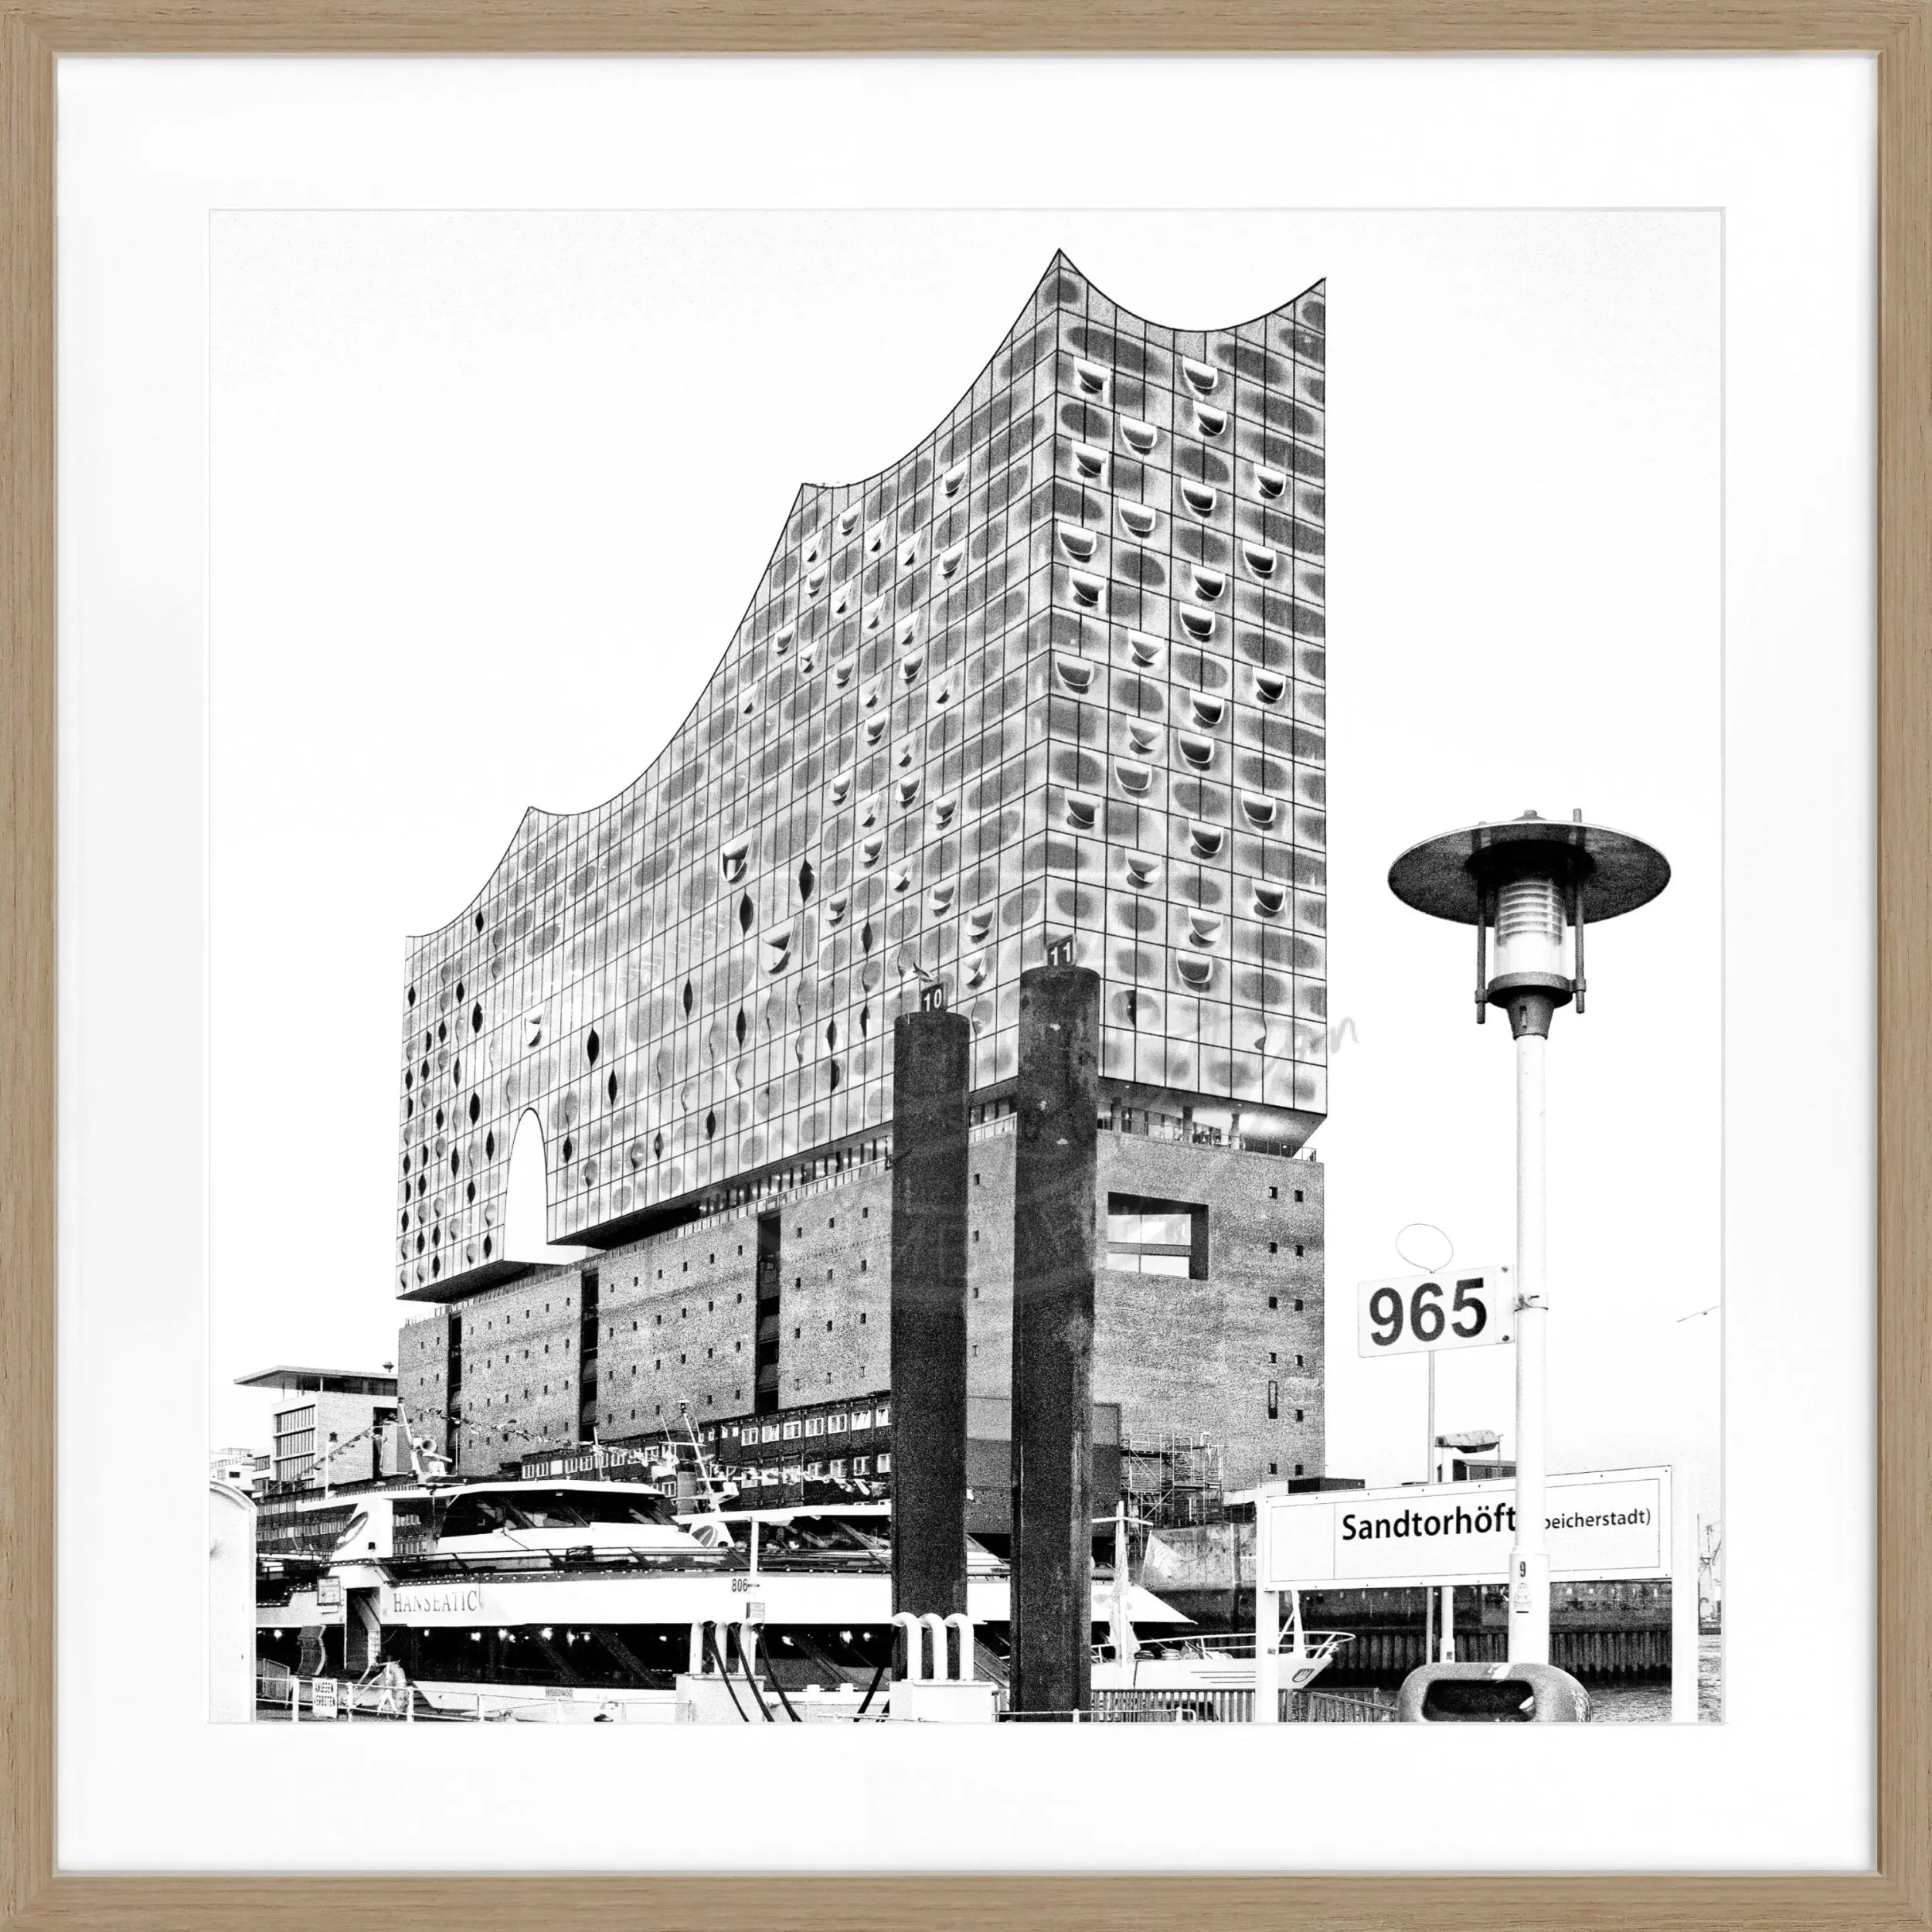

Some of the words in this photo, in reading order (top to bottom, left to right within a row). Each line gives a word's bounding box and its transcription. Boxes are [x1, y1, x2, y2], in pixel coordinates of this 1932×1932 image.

[1049, 941, 1072, 966] 11
[923, 988, 943, 1012] 10
[1369, 1277, 1487, 1346] 965
[1342, 1502, 1515, 1540] Sandtorhöft
[1519, 1561, 1526, 1577] 9
[732, 1578, 748, 1592] 806
[393, 1590, 478, 1612] HANSEATIC
